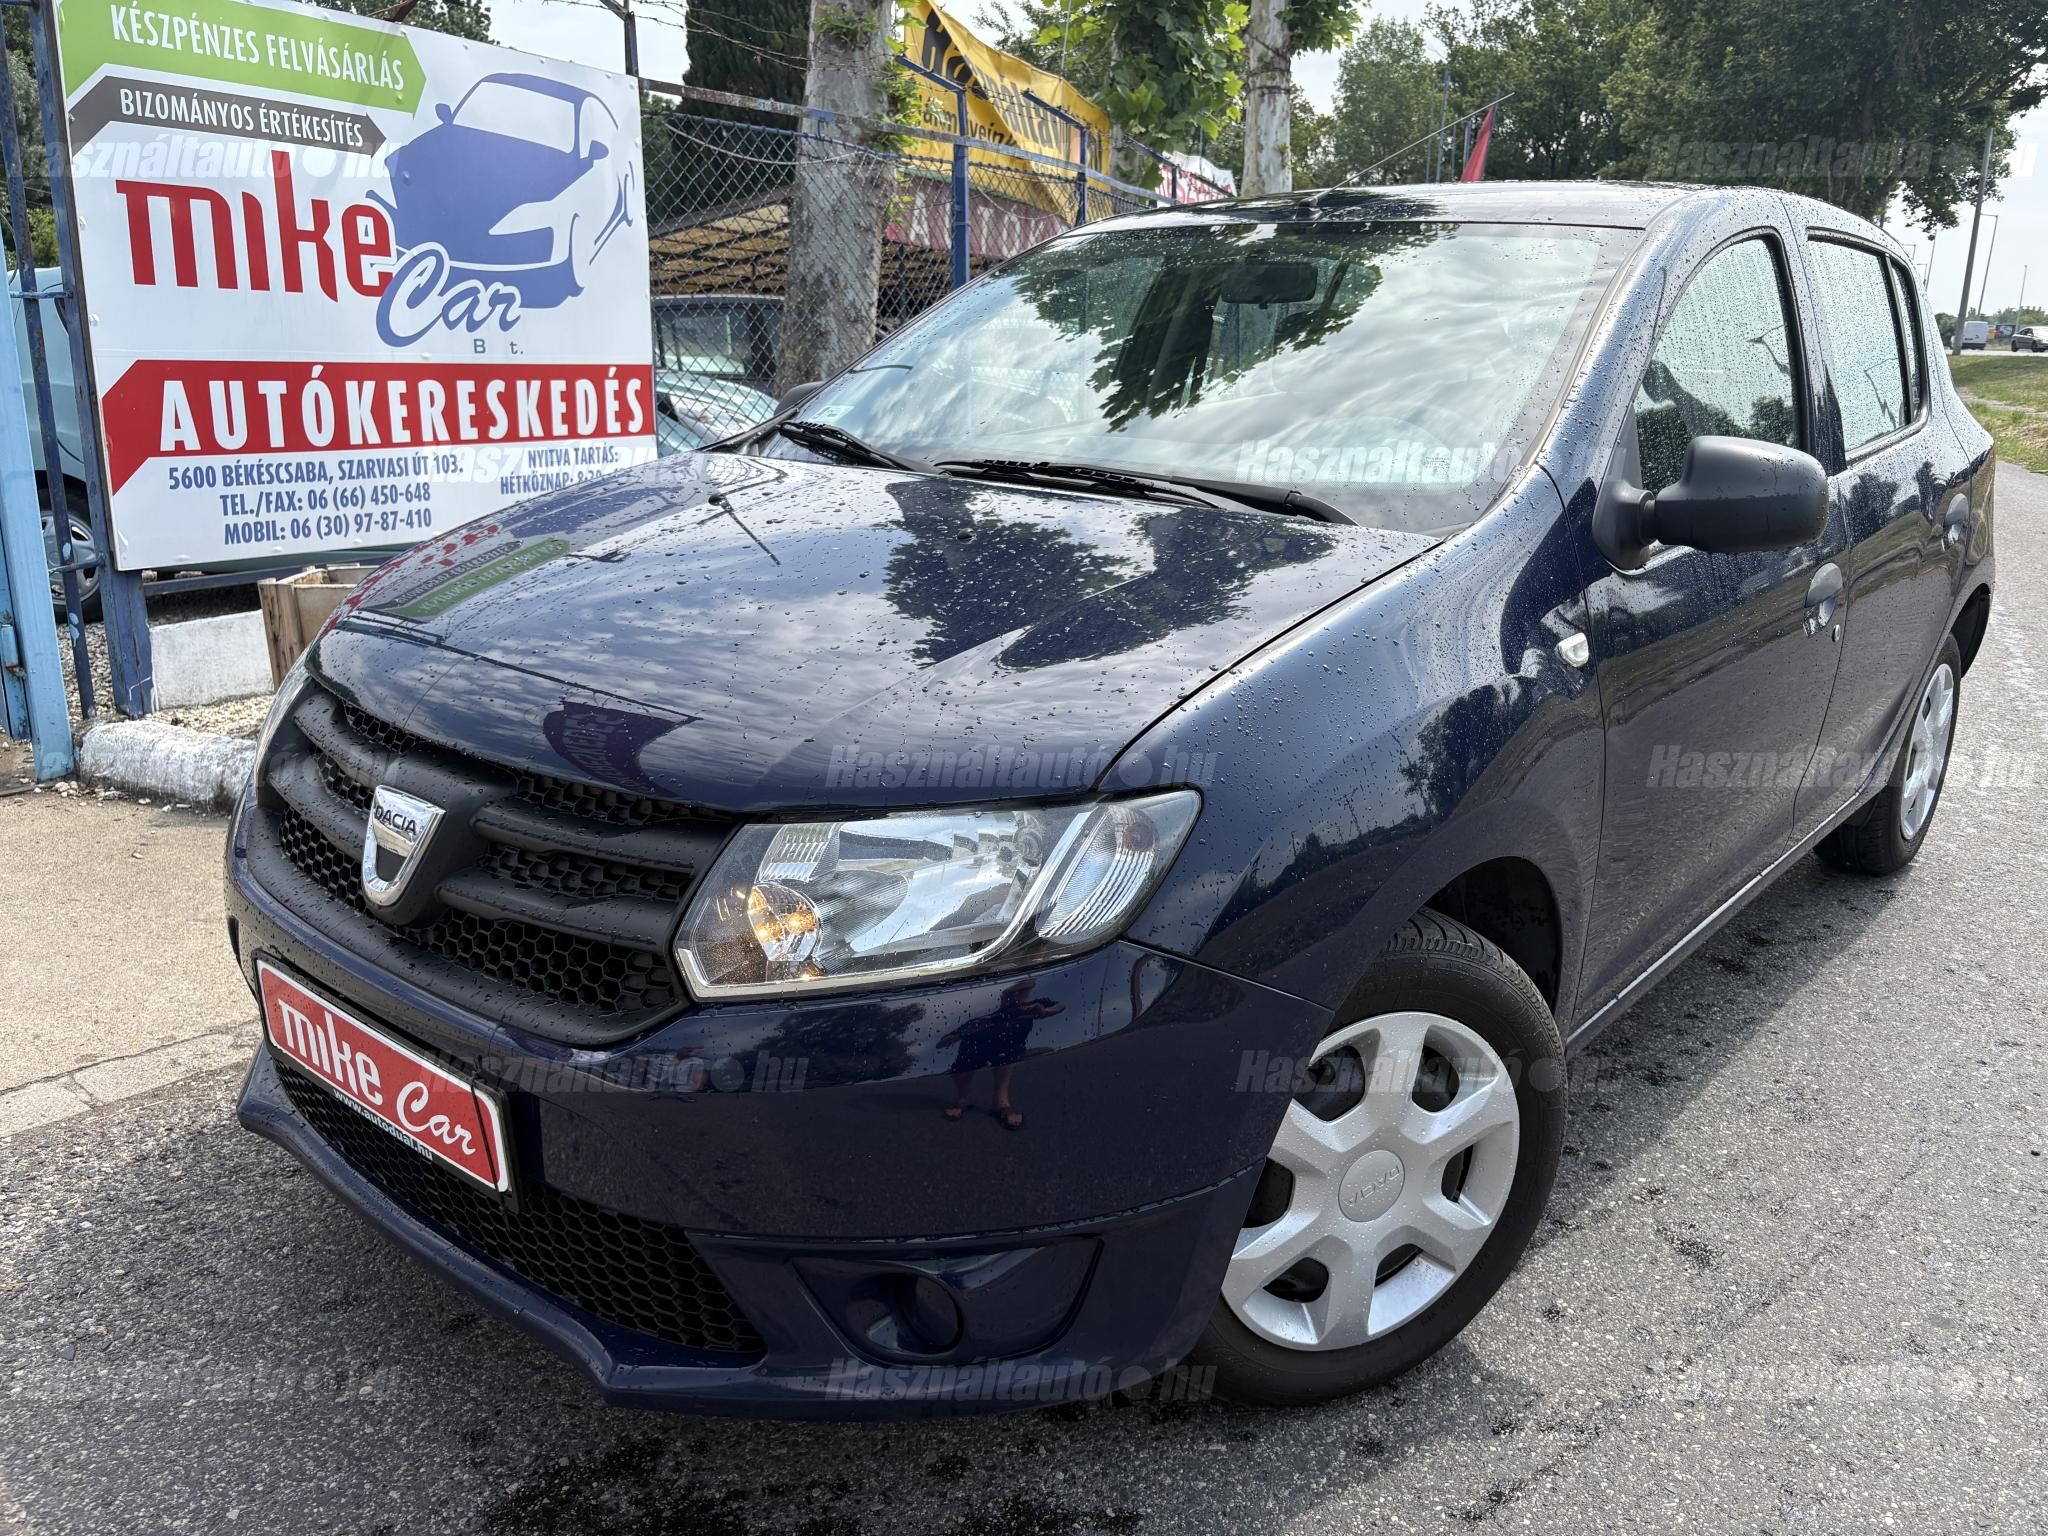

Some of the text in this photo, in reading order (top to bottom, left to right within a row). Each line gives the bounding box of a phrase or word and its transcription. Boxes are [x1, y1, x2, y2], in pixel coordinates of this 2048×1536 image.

[111, 1, 405, 92] KÉSZPÉNZES FELVÁSÁRLÁS
[119, 88, 364, 148] BIZOMÁNYOS ÉRTÉKESÍTÉS
[116, 149, 521, 348] mike Car
[160, 365, 642, 451] AUTÓKERESKEDÉS
[169, 453, 464, 489] 5600 BÉKÉSCSABA, SZARVASI ÚT 103.
[528, 442, 619, 468] NYITVA TARTÁS:
[220, 482, 431, 517] TEL./FAX: 06 (66) 450-648
[224, 508, 432, 545] MOBIL: 06 (30) 97-87-410
[374, 805, 416, 836] DACIA
[278, 998, 476, 1155] mike Car
[333, 1088, 433, 1161] www.autodual.hu
[1343, 1165, 1400, 1207] DACIA
